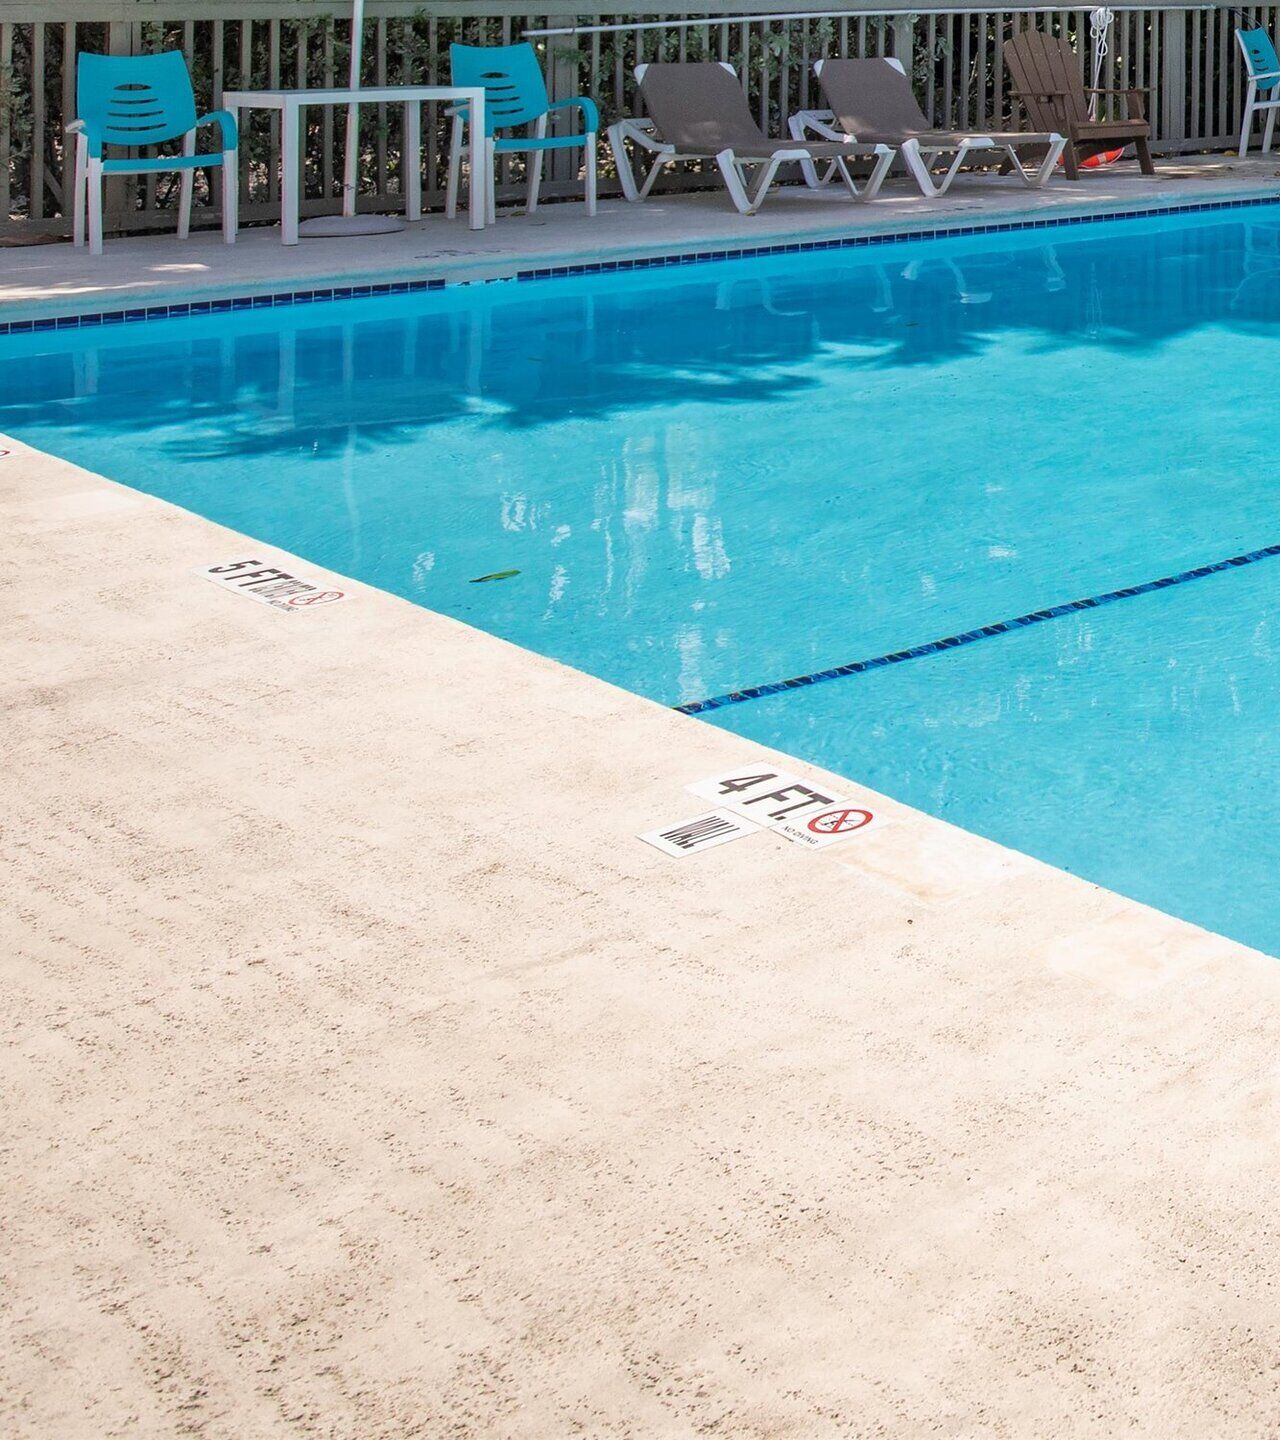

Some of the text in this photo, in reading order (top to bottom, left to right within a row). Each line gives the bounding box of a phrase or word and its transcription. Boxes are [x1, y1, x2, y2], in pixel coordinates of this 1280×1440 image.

[208, 560, 294, 587] 5 FT
[718, 773, 836, 821] 4 FT.
